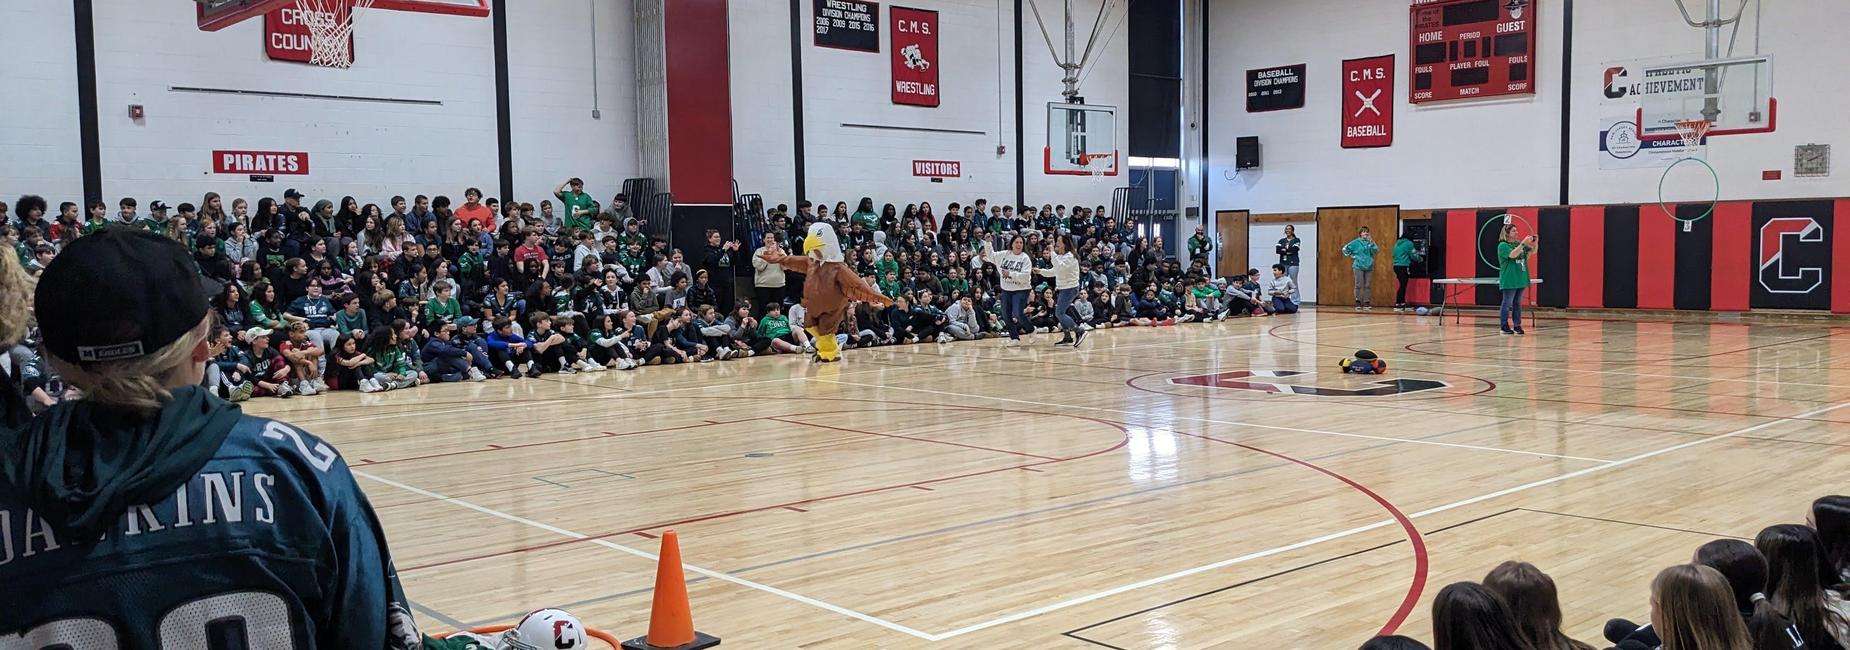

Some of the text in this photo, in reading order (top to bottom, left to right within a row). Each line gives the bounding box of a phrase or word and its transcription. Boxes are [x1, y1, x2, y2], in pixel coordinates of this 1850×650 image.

[827, 0, 867, 12] WRESTLING
[823, 8, 871, 22] DIVISION CHAMPIONS
[816, 17, 875, 31] 2006 2009 2015 2016
[1496, 21, 1526, 33] GUEST
[817, 26, 829, 34] 2017
[1459, 31, 1480, 40] PERIOD
[1419, 31, 1443, 42] HOME
[1450, 59, 1490, 70] PLAYER FOUL
[1509, 56, 1528, 64] FOULS
[1257, 69, 1294, 79] BASEBALL
[1415, 66, 1433, 74] FOULS
[896, 80, 936, 96] WRESTLING
[1460, 87, 1480, 95] MATCH
[1414, 91, 1433, 99] SCORE
[1347, 125, 1387, 137] BASEBALL
[223, 153, 299, 172] PIRATES
[915, 162, 959, 175] VISITORS
[1759, 217, 1823, 294] C
